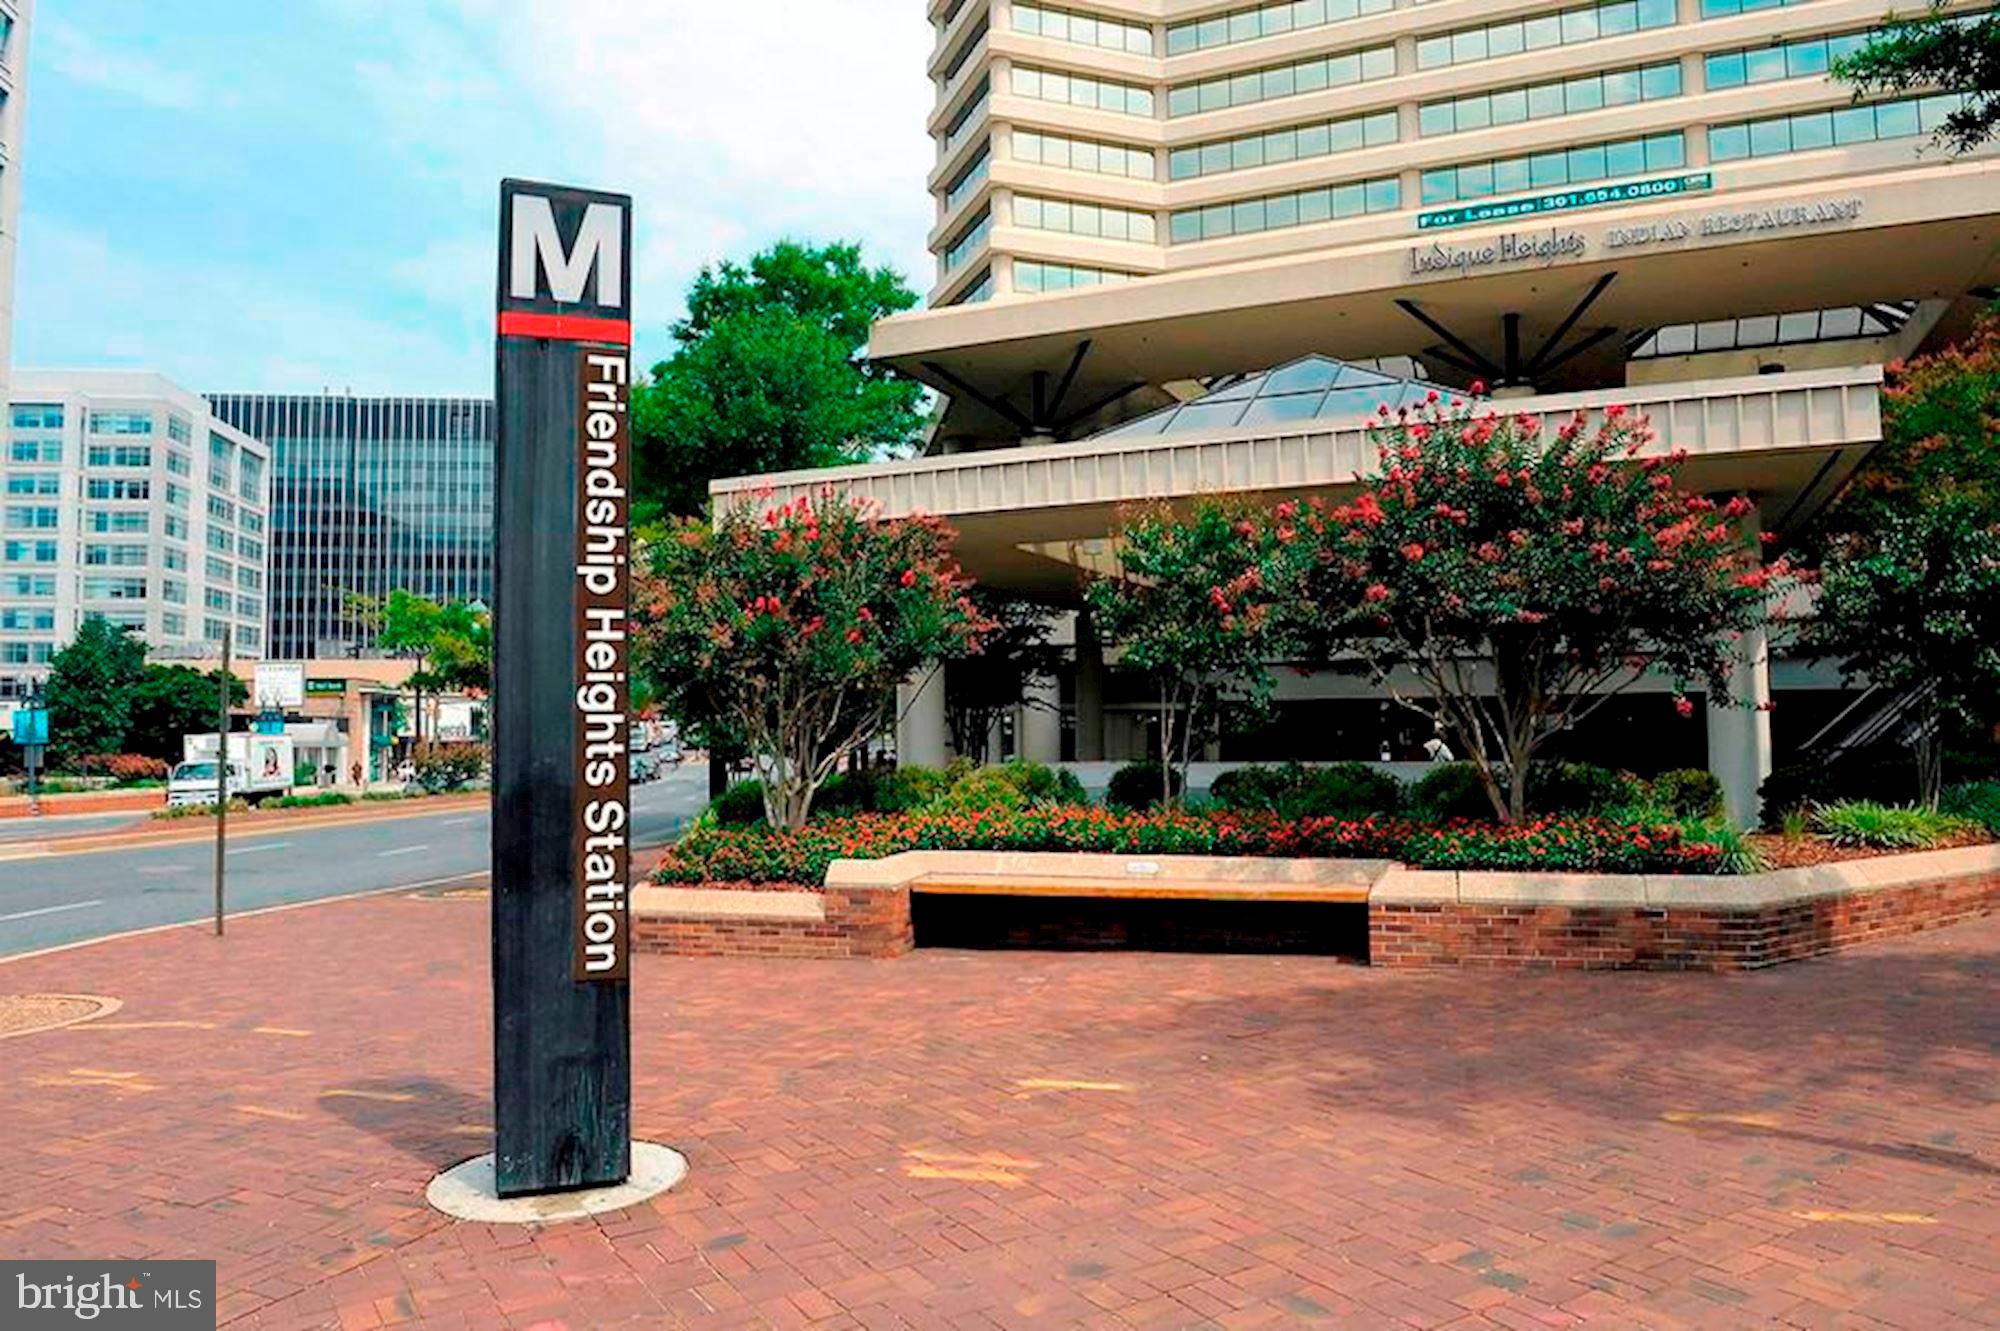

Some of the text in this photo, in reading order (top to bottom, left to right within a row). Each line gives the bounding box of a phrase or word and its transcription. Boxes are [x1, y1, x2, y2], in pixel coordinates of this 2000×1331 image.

[1419, 213, 1458, 228] For
[1464, 202, 1535, 221] Lease
[1606, 198, 1863, 248] INDIAN RESTAURANT
[509, 192, 623, 308] M
[1410, 226, 1586, 274] Indique Heights
[576, 353, 627, 973] Friendship Heights Station
